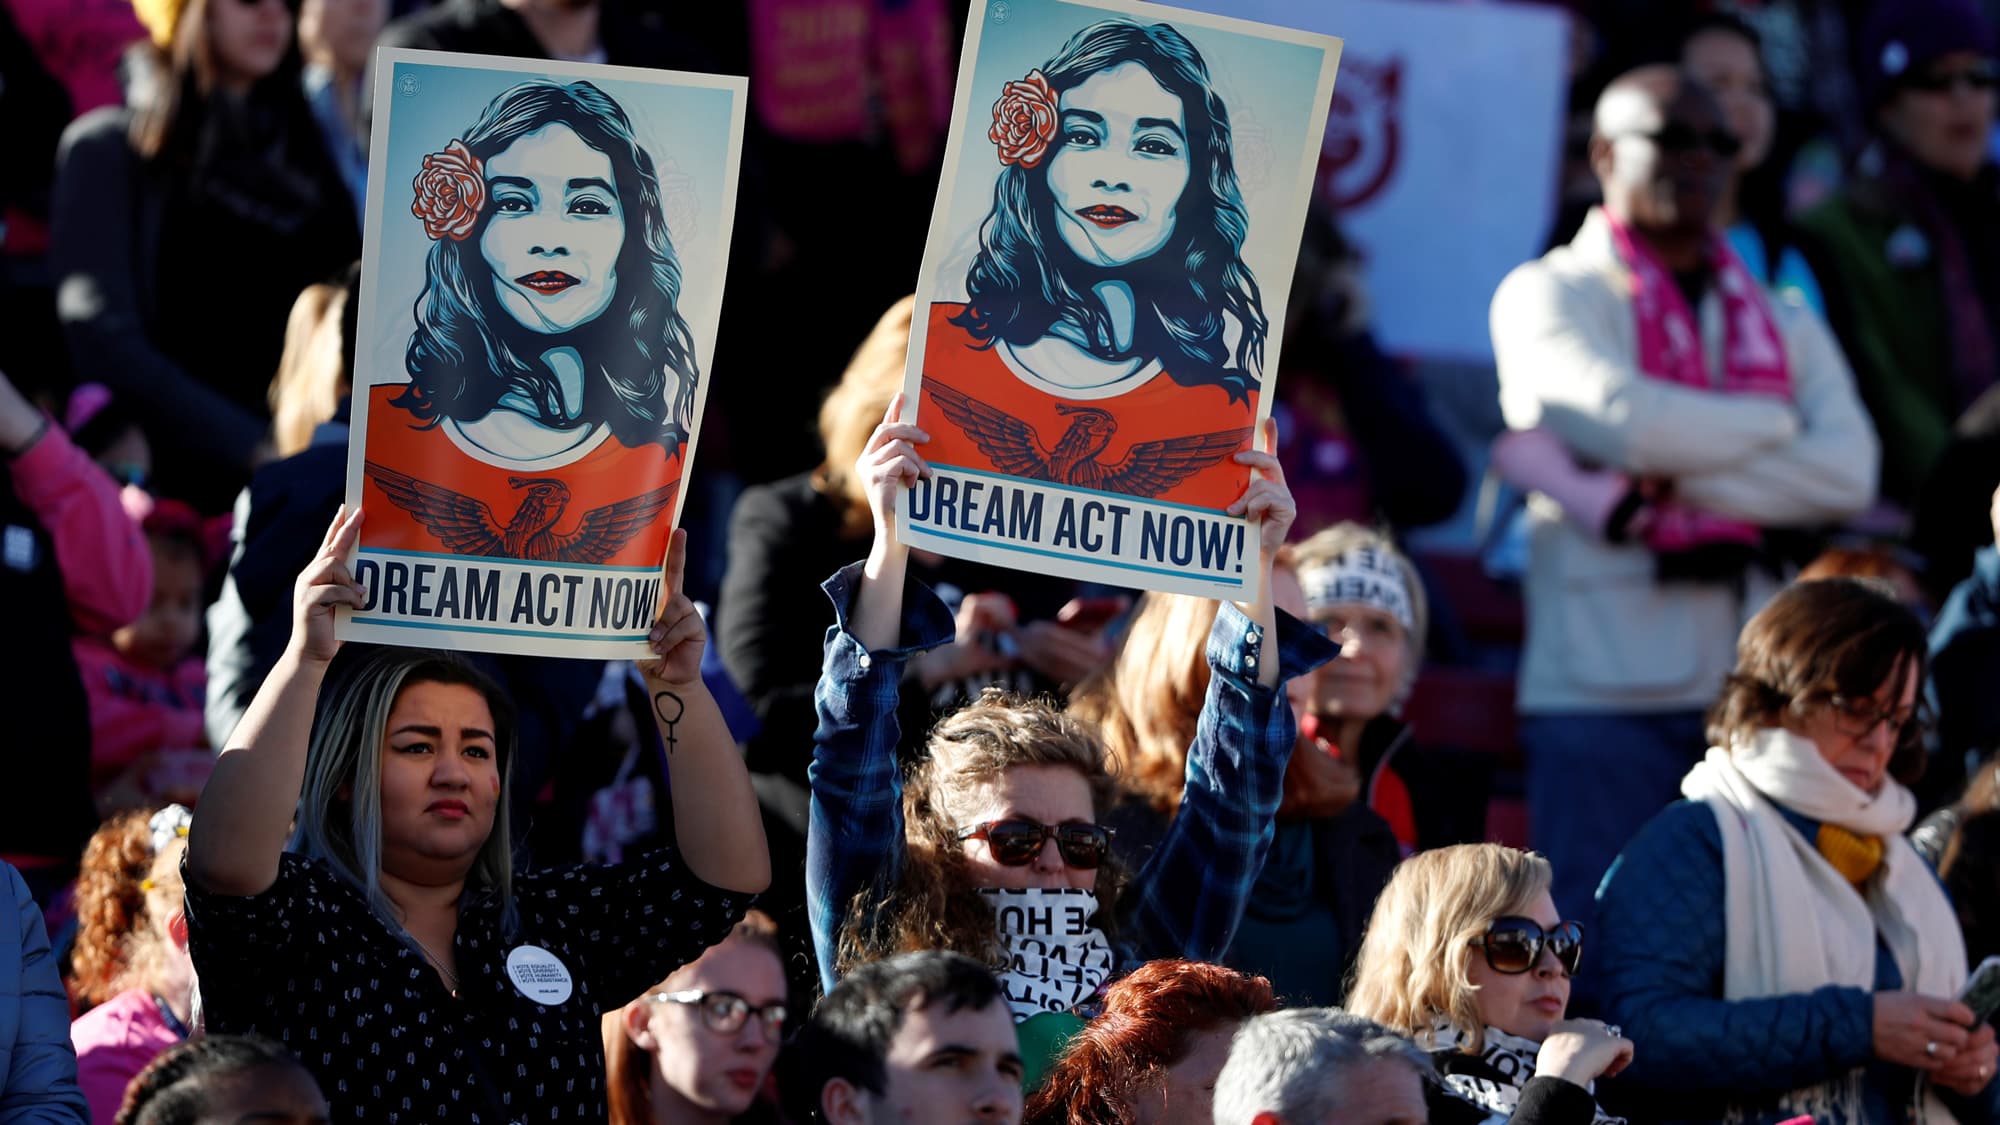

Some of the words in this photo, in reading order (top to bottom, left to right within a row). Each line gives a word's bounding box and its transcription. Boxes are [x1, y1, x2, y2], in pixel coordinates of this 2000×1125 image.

[908, 476, 1044, 542] DREAM
[1053, 497, 1131, 556] ACT
[1140, 510, 1245, 573] NOW!
[352, 558, 501, 622] DREAM
[510, 572, 584, 627] ACT
[588, 577, 660, 630] NOW!
